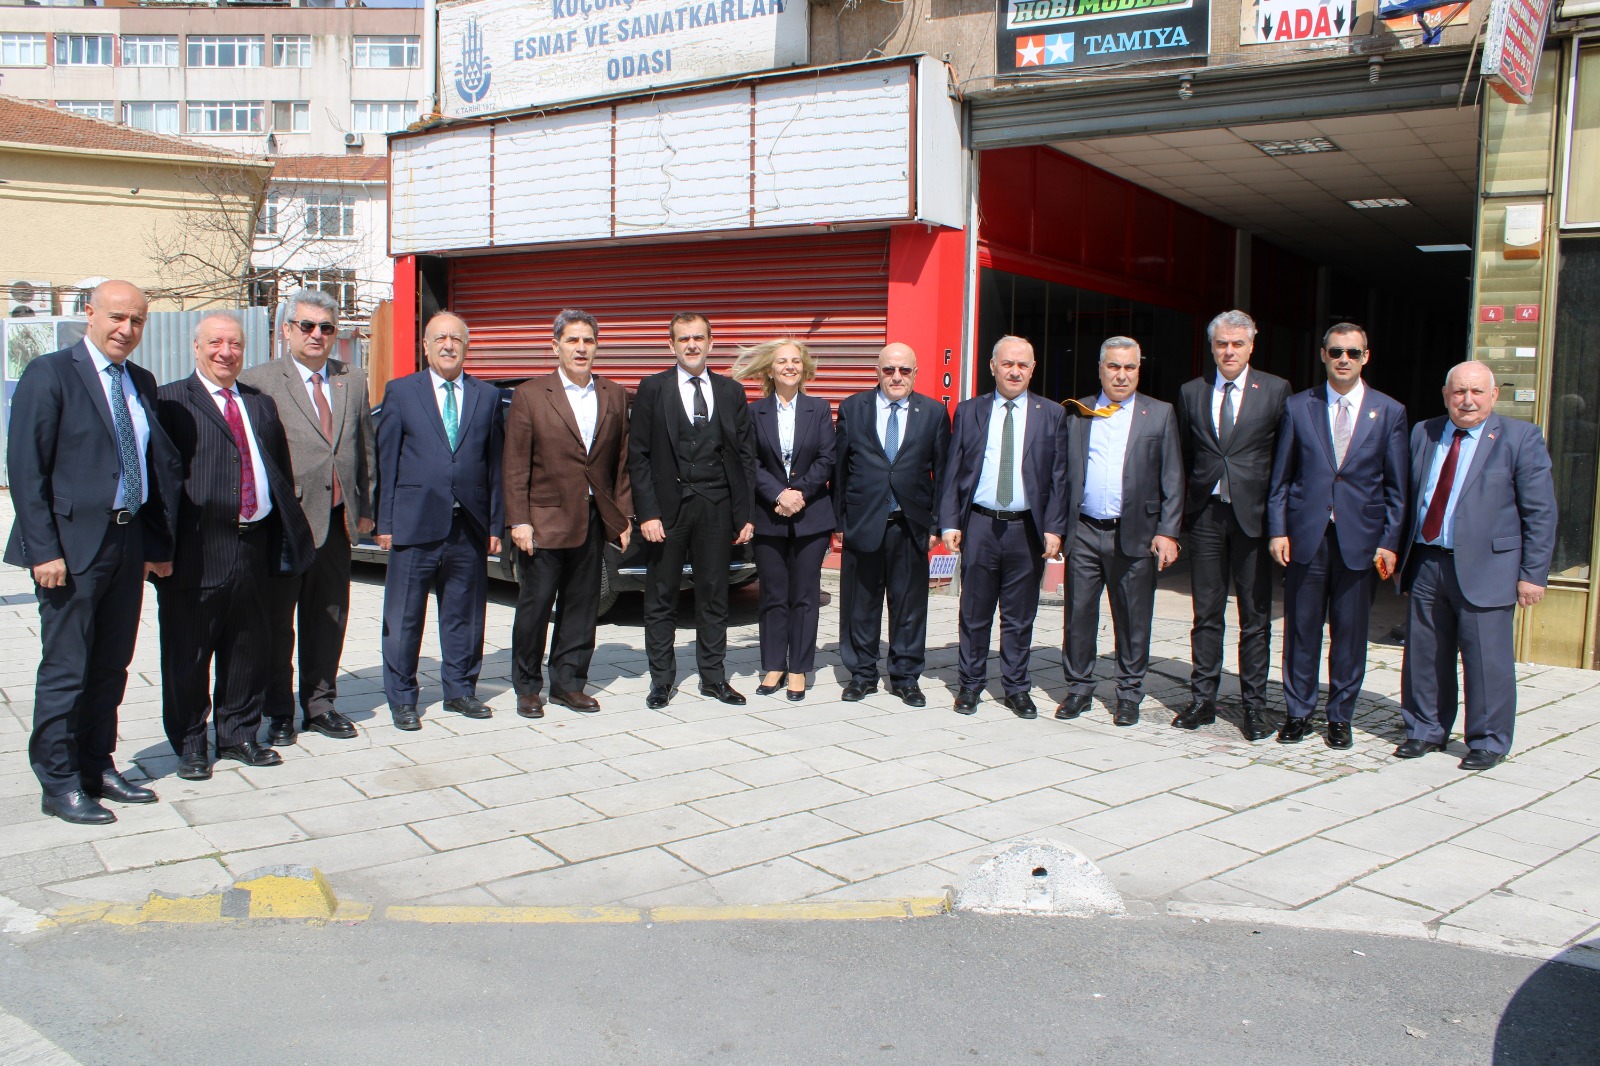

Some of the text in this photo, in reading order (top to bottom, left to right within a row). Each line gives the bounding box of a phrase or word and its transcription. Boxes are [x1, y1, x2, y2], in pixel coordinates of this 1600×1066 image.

[514, 0, 784, 61] ESNAF VE SANATKARLAR
[1275, 6, 1332, 41] ADA
[1083, 26, 1190, 55] TAMIYA
[607, 49, 672, 81] ODASI
[1488, 309, 1495, 319] 4
